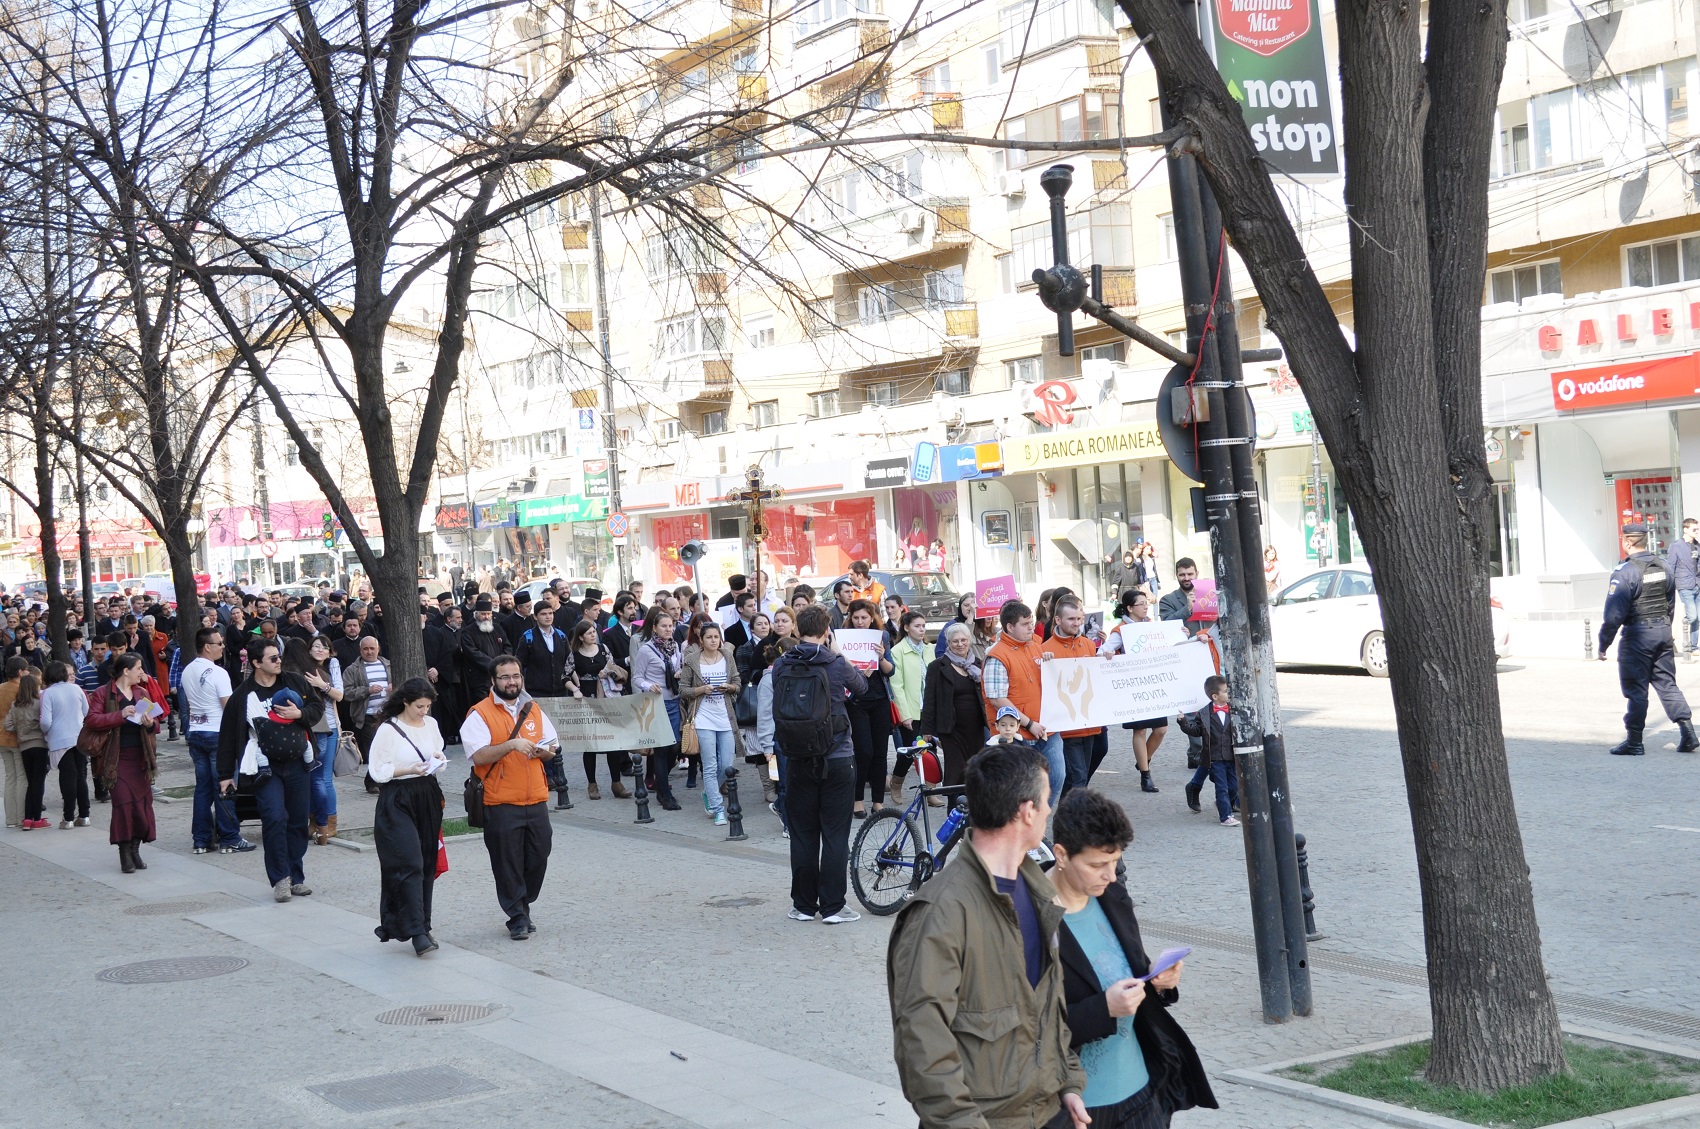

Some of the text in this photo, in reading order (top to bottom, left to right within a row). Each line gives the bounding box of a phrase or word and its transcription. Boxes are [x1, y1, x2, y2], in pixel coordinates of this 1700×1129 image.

[1231, 0, 1296, 12] Mamma
[1233, 31, 1258, 47] Catering
[1264, 31, 1296, 46] Restaurant
[1242, 80, 1319, 108] non
[1250, 114, 1332, 162] stop
[1578, 375, 1645, 394] vodafone
[1043, 439, 1085, 459] BANCA
[590, 486, 609, 495] stop
[1112, 672, 1178, 690] DEPARTAMENTUL
[1132, 689, 1168, 702] PRO VITA
